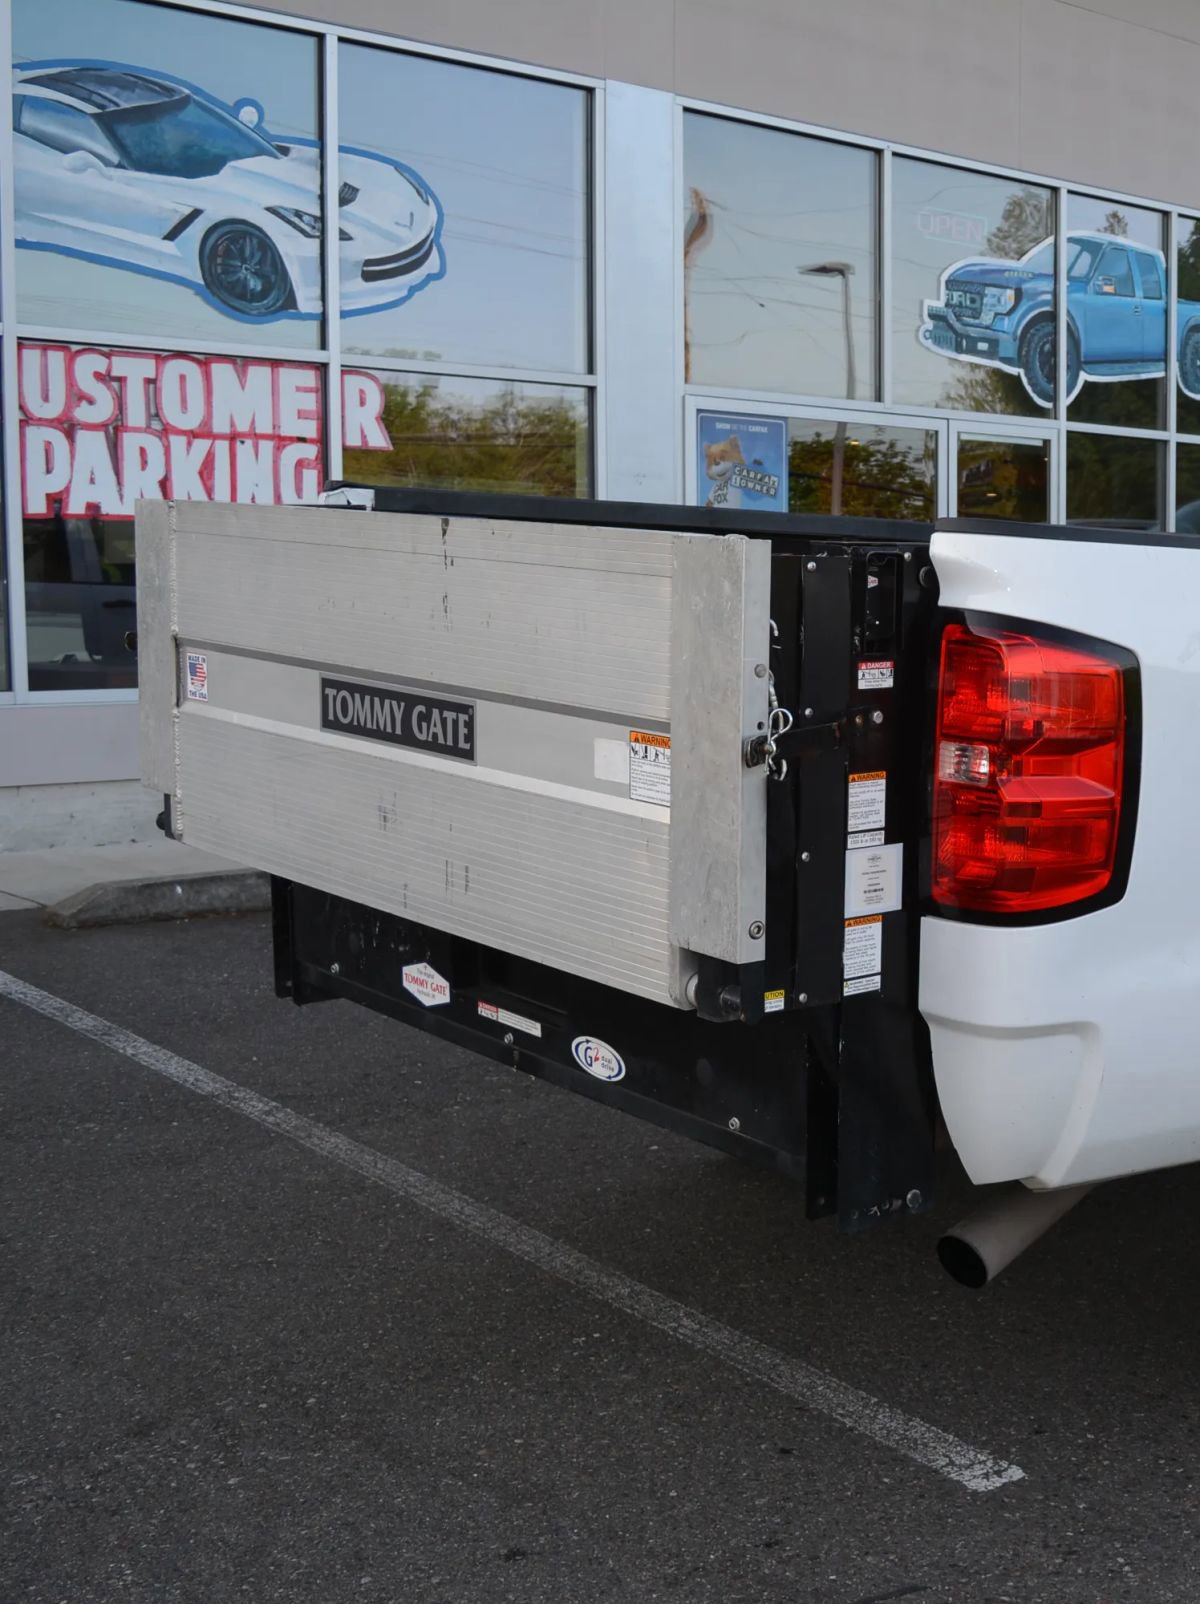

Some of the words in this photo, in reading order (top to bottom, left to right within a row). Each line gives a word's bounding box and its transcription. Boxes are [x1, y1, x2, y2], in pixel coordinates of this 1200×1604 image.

[918, 211, 982, 241] OPEN
[748, 425, 768, 433] CARFAX
[21, 419, 324, 519] PARKING
[735, 466, 778, 487] CARFAX
[740, 479, 777, 497] OWNER
[188, 655, 200, 663] MADE
[867, 661, 891, 669] DANGER
[325, 687, 405, 735] TOMMY
[411, 704, 471, 750] GATE
[857, 772, 885, 782] WARNING
[853, 914, 880, 926] WARNING
[404, 972, 428, 990] TOMMY
[430, 982, 447, 997] GATE
[601, 1062, 615, 1073] drive
